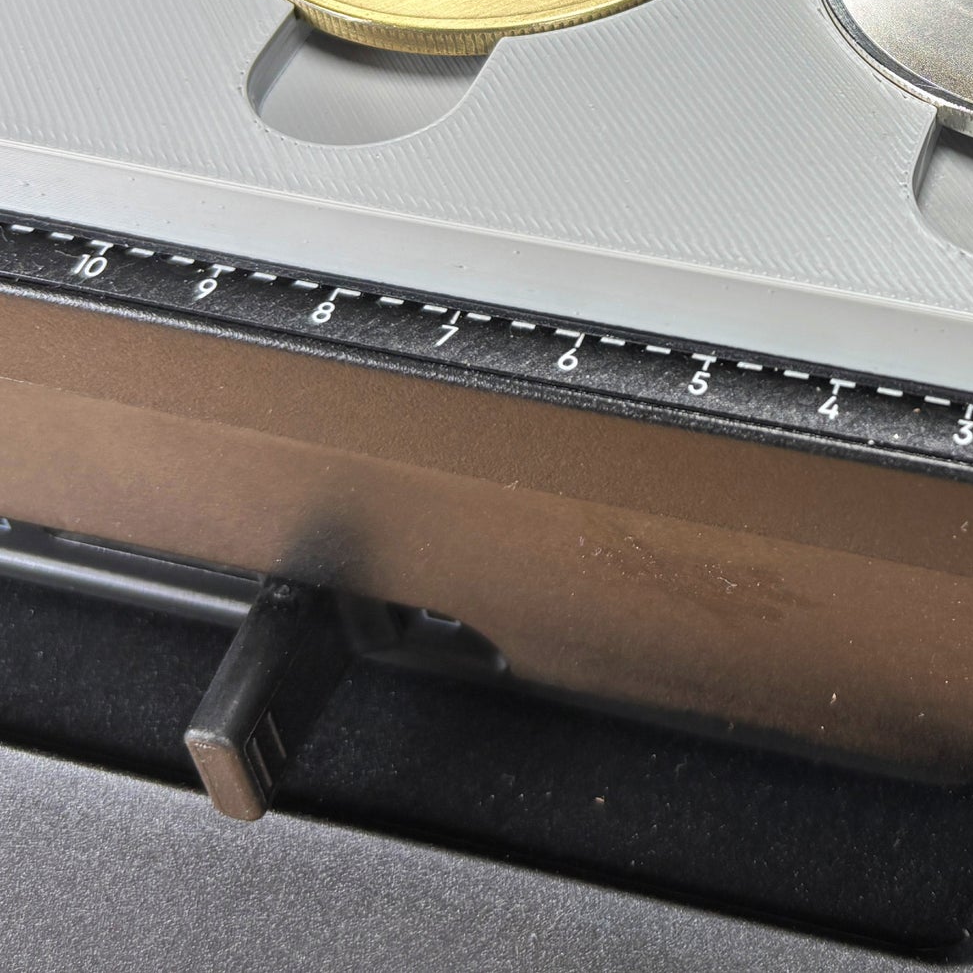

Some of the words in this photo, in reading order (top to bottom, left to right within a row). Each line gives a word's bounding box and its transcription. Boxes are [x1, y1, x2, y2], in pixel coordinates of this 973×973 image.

[73, 254, 108, 278] 10
[194, 278, 218, 301] 9
[310, 300, 336, 324] 8
[434, 325, 459, 348] 7
[556, 347, 579, 372] 6
[687, 371, 709, 396] 5
[818, 395, 839, 421] 4
